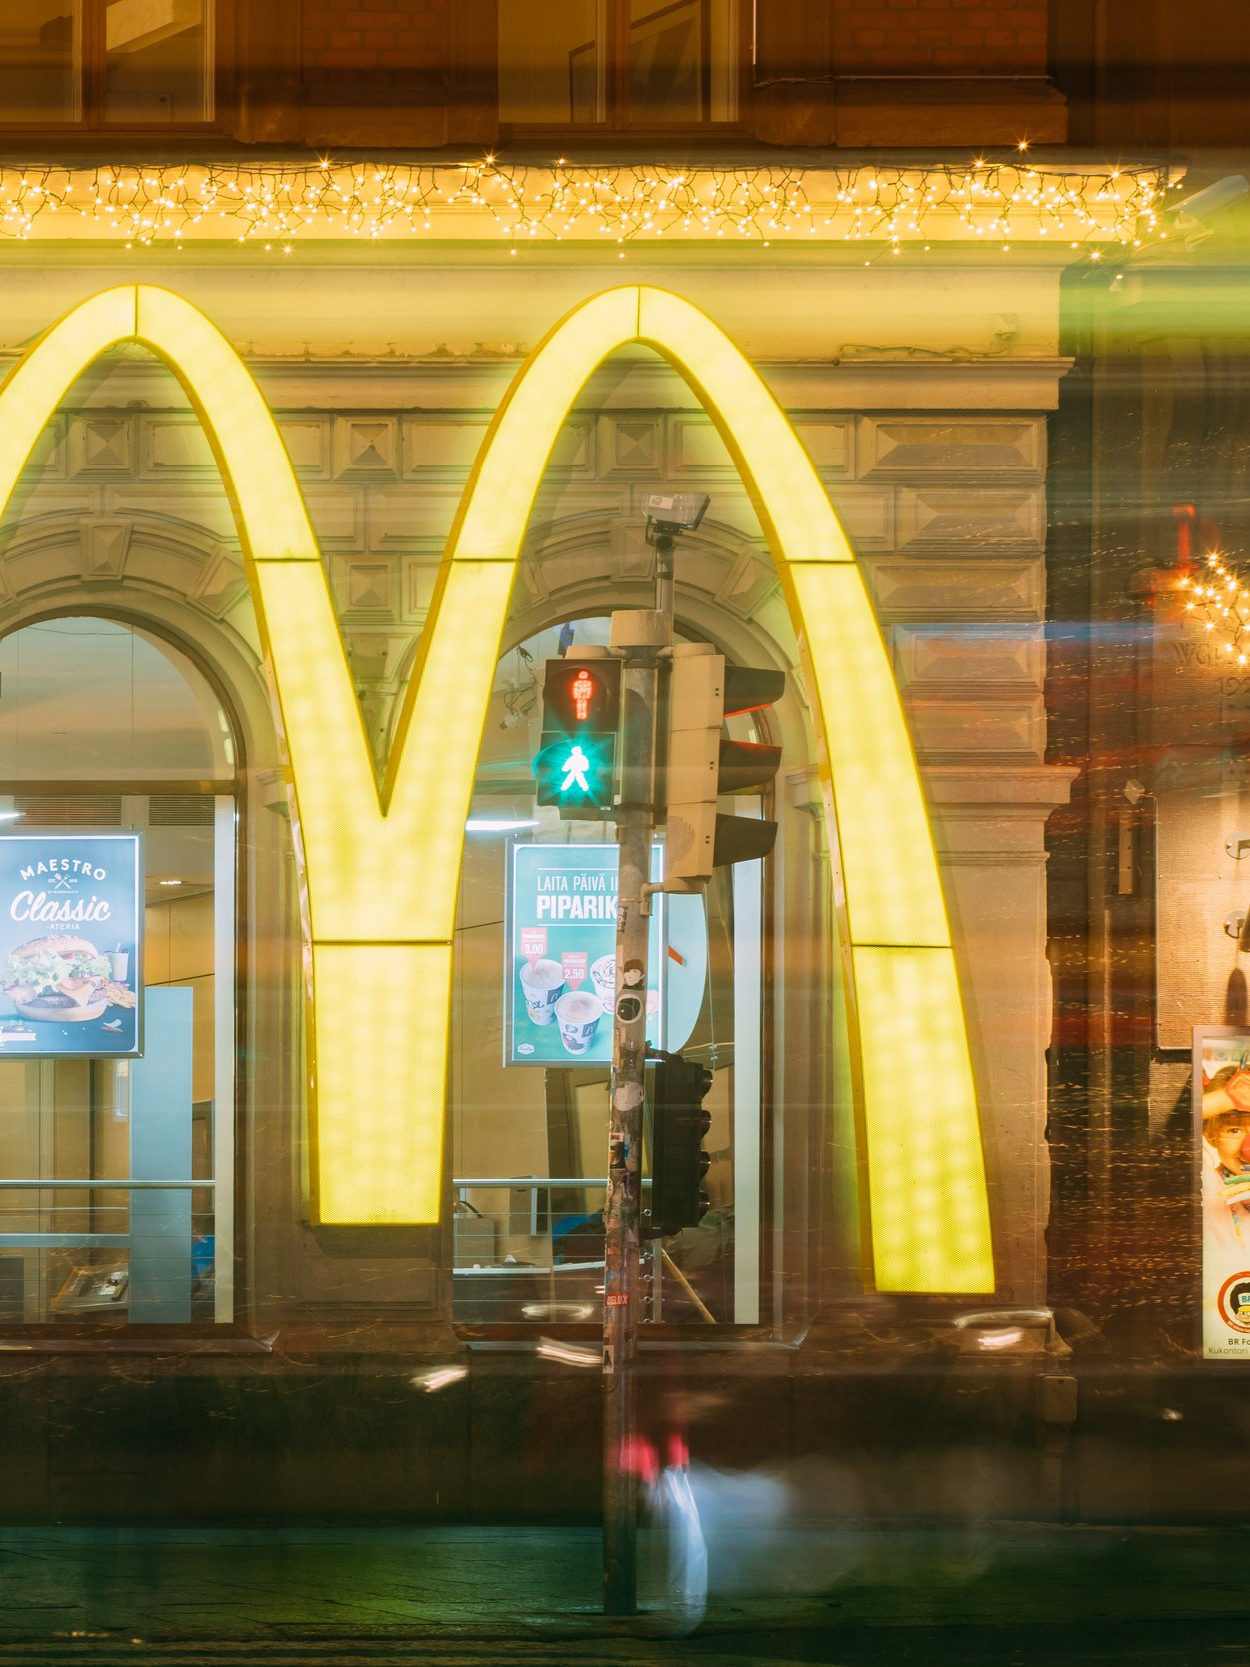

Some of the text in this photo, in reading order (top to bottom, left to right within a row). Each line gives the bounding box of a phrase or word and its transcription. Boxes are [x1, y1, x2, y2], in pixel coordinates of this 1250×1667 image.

[19, 858, 107, 881] MAESTRO
[537, 876, 568, 891] LAITA
[573, 872, 605, 891] PÄIVÄ
[9, 890, 111, 922] Classic
[524, 943, 544, 956] 3,00
[564, 968, 584, 981] 2,50
[1228, 1338, 1239, 1346] BR
[1208, 1347, 1248, 1355] Kukontori
